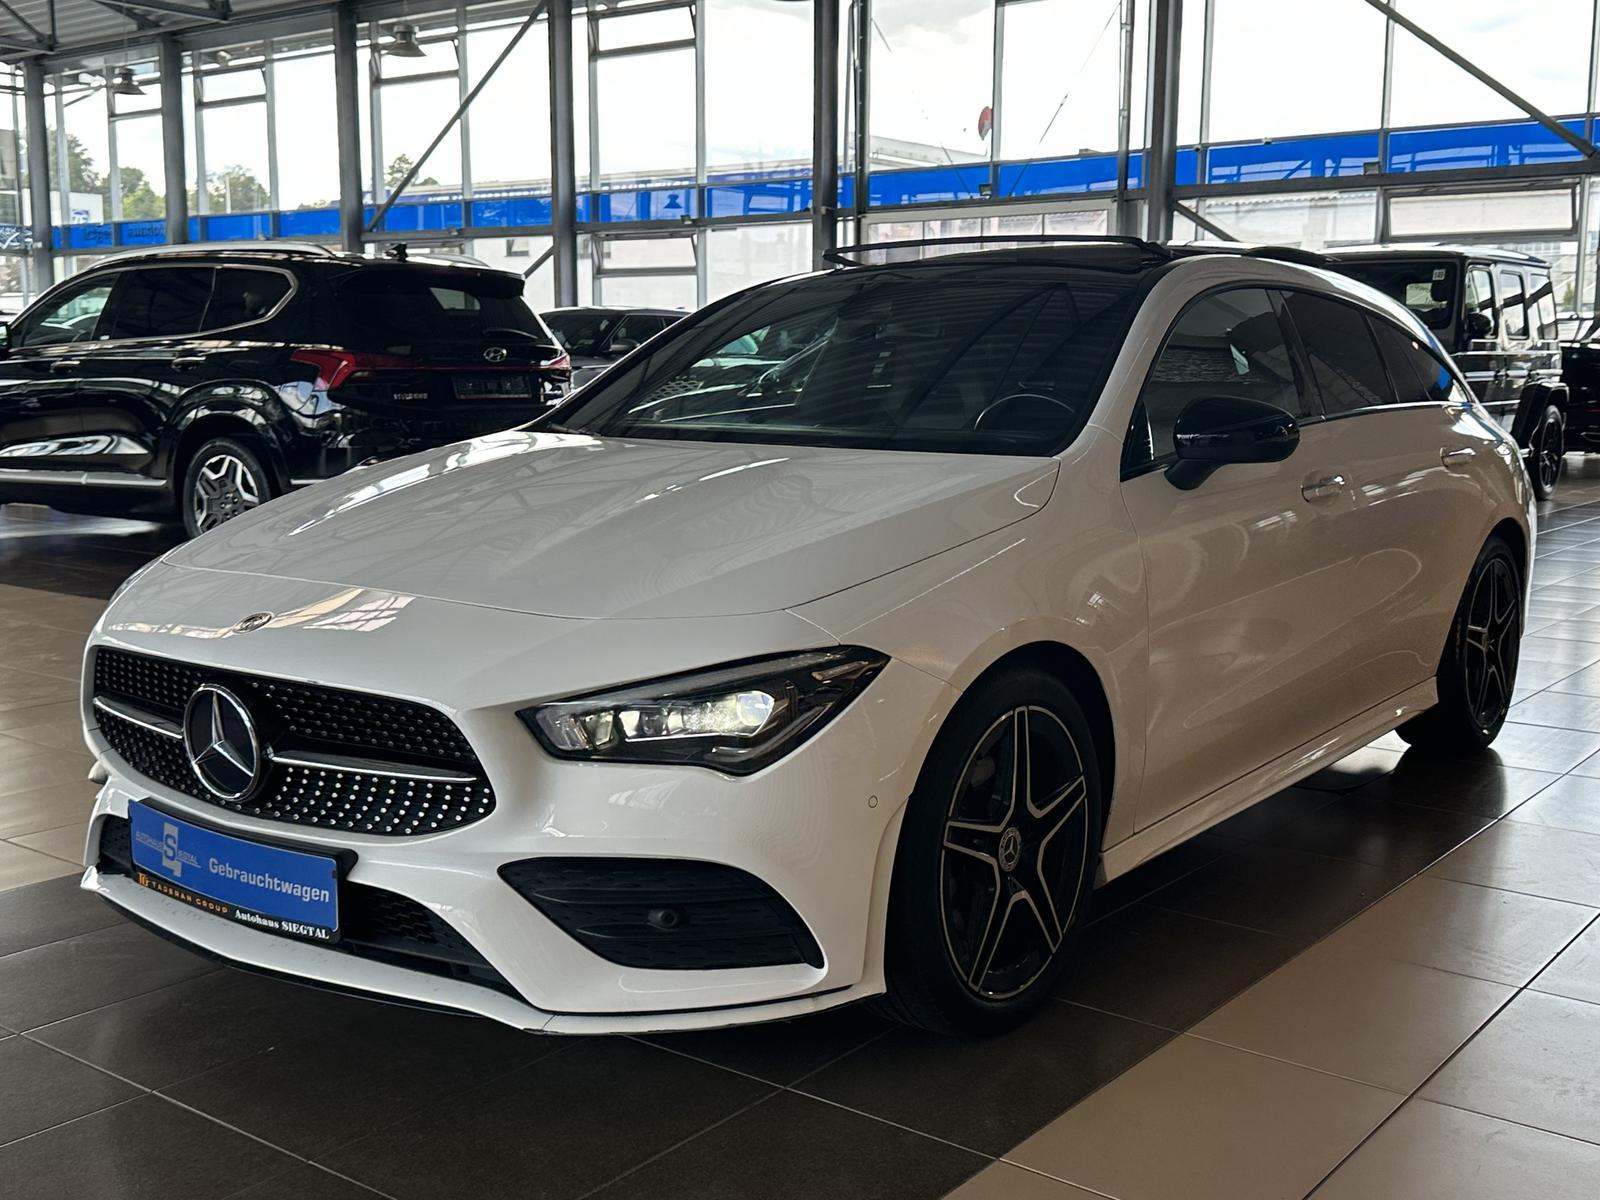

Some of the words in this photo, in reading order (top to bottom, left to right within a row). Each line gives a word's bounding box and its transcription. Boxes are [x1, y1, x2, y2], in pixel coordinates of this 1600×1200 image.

[208, 857, 330, 903] Gebrauchtwagen
[234, 909, 280, 929] Autohaus
[281, 920, 330, 940] SIEGTAL
